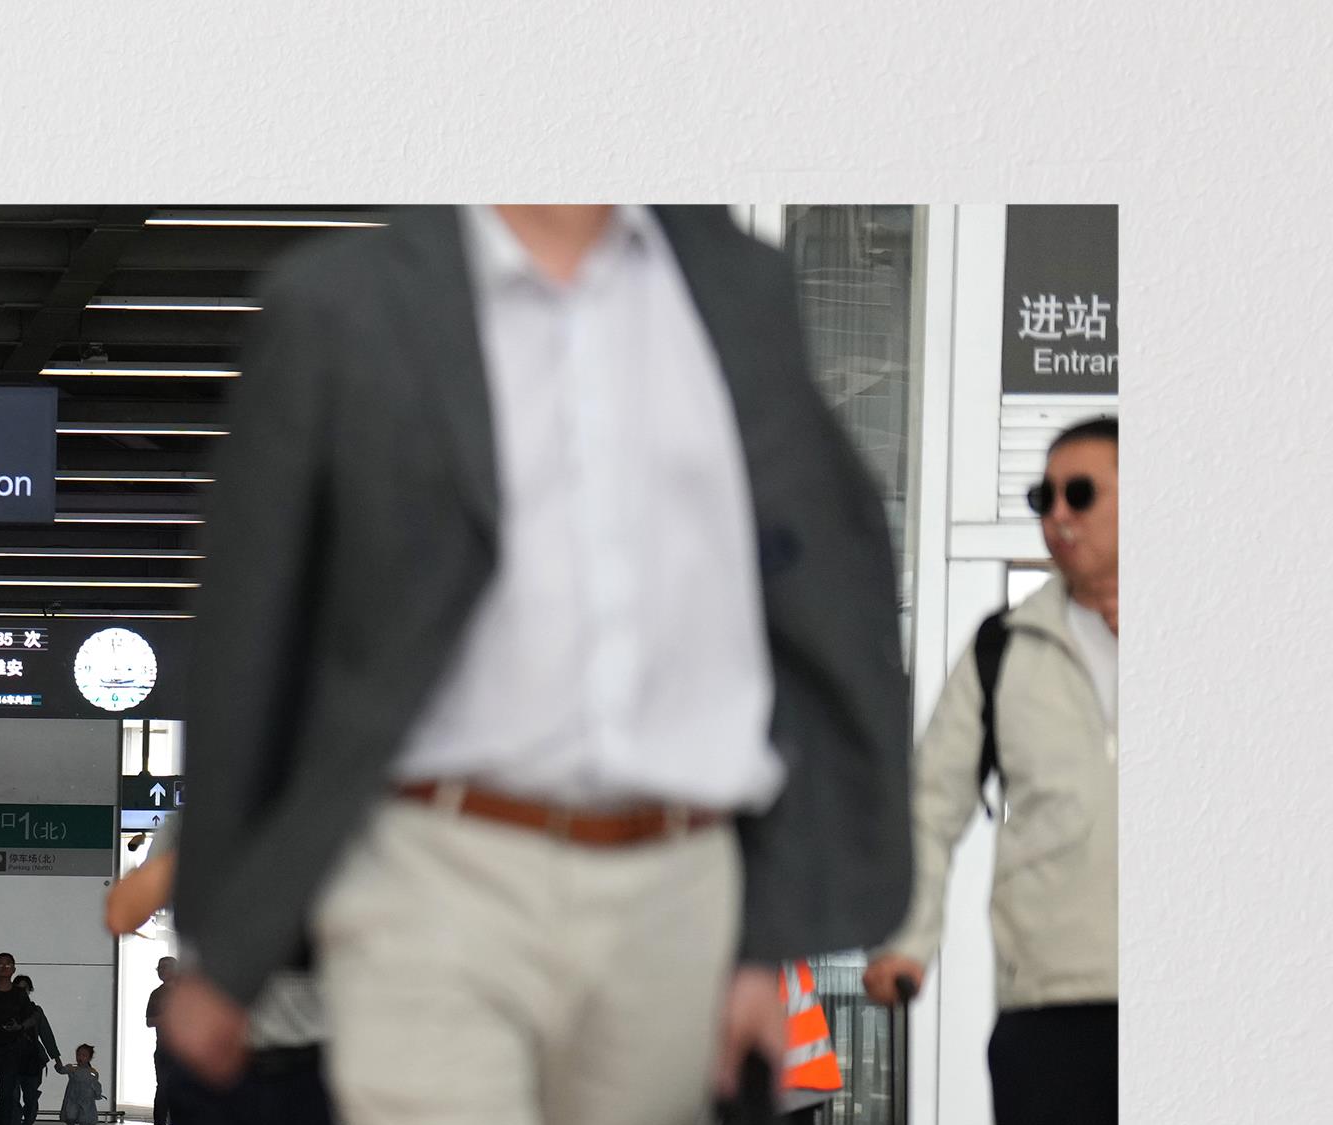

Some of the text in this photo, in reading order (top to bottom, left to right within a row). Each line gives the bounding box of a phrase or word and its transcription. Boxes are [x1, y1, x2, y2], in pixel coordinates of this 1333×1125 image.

[1018, 292, 1118, 341] 进站
[23, 630, 42, 648] 次
[9, 855, 57, 865] 停车场(北)
